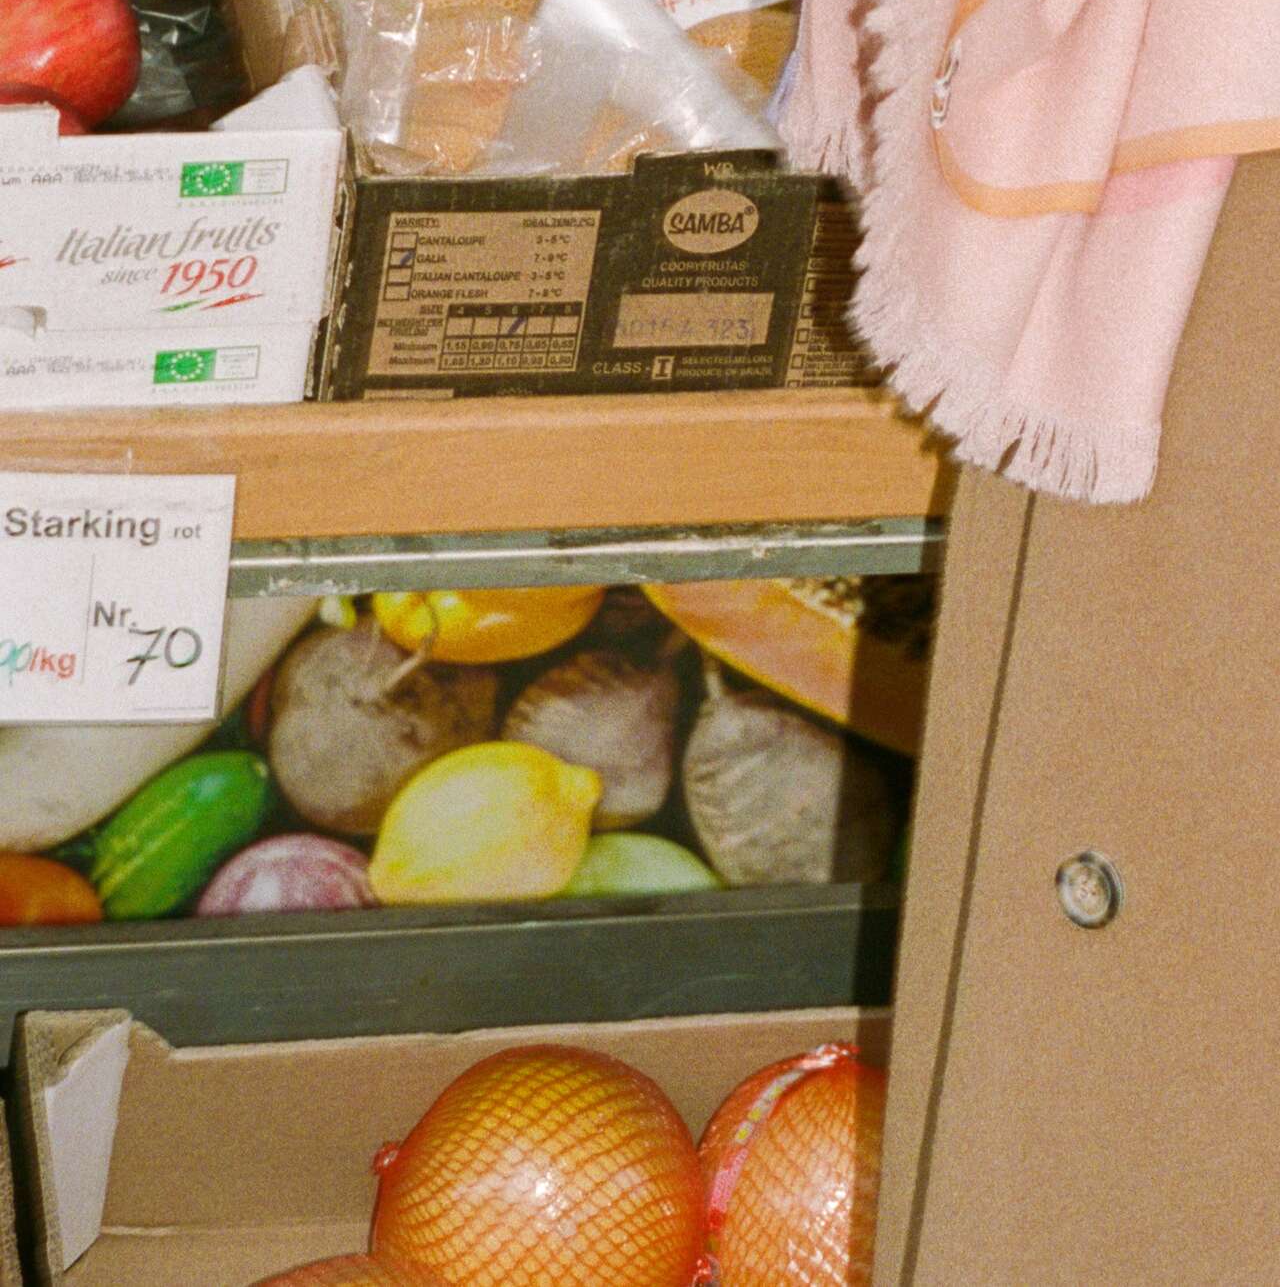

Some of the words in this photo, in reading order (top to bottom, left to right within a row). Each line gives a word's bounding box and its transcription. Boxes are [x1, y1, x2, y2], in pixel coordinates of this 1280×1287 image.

[668, 212, 745, 234] SAMBA
[55, 225, 170, 265] Italian
[166, 216, 281, 258] fruits
[419, 236, 486, 245] CANTALOUPE
[101, 267, 158, 286] since
[159, 255, 258, 297] 1950
[642, 276, 693, 288] QUALITY
[694, 276, 759, 288] PRODUCTS
[592, 361, 641, 375] CLASS
[5, 507, 161, 547] Starking
[173, 523, 202, 539] rot
[93, 600, 137, 628] Nr.
[126, 626, 204, 686] 70
